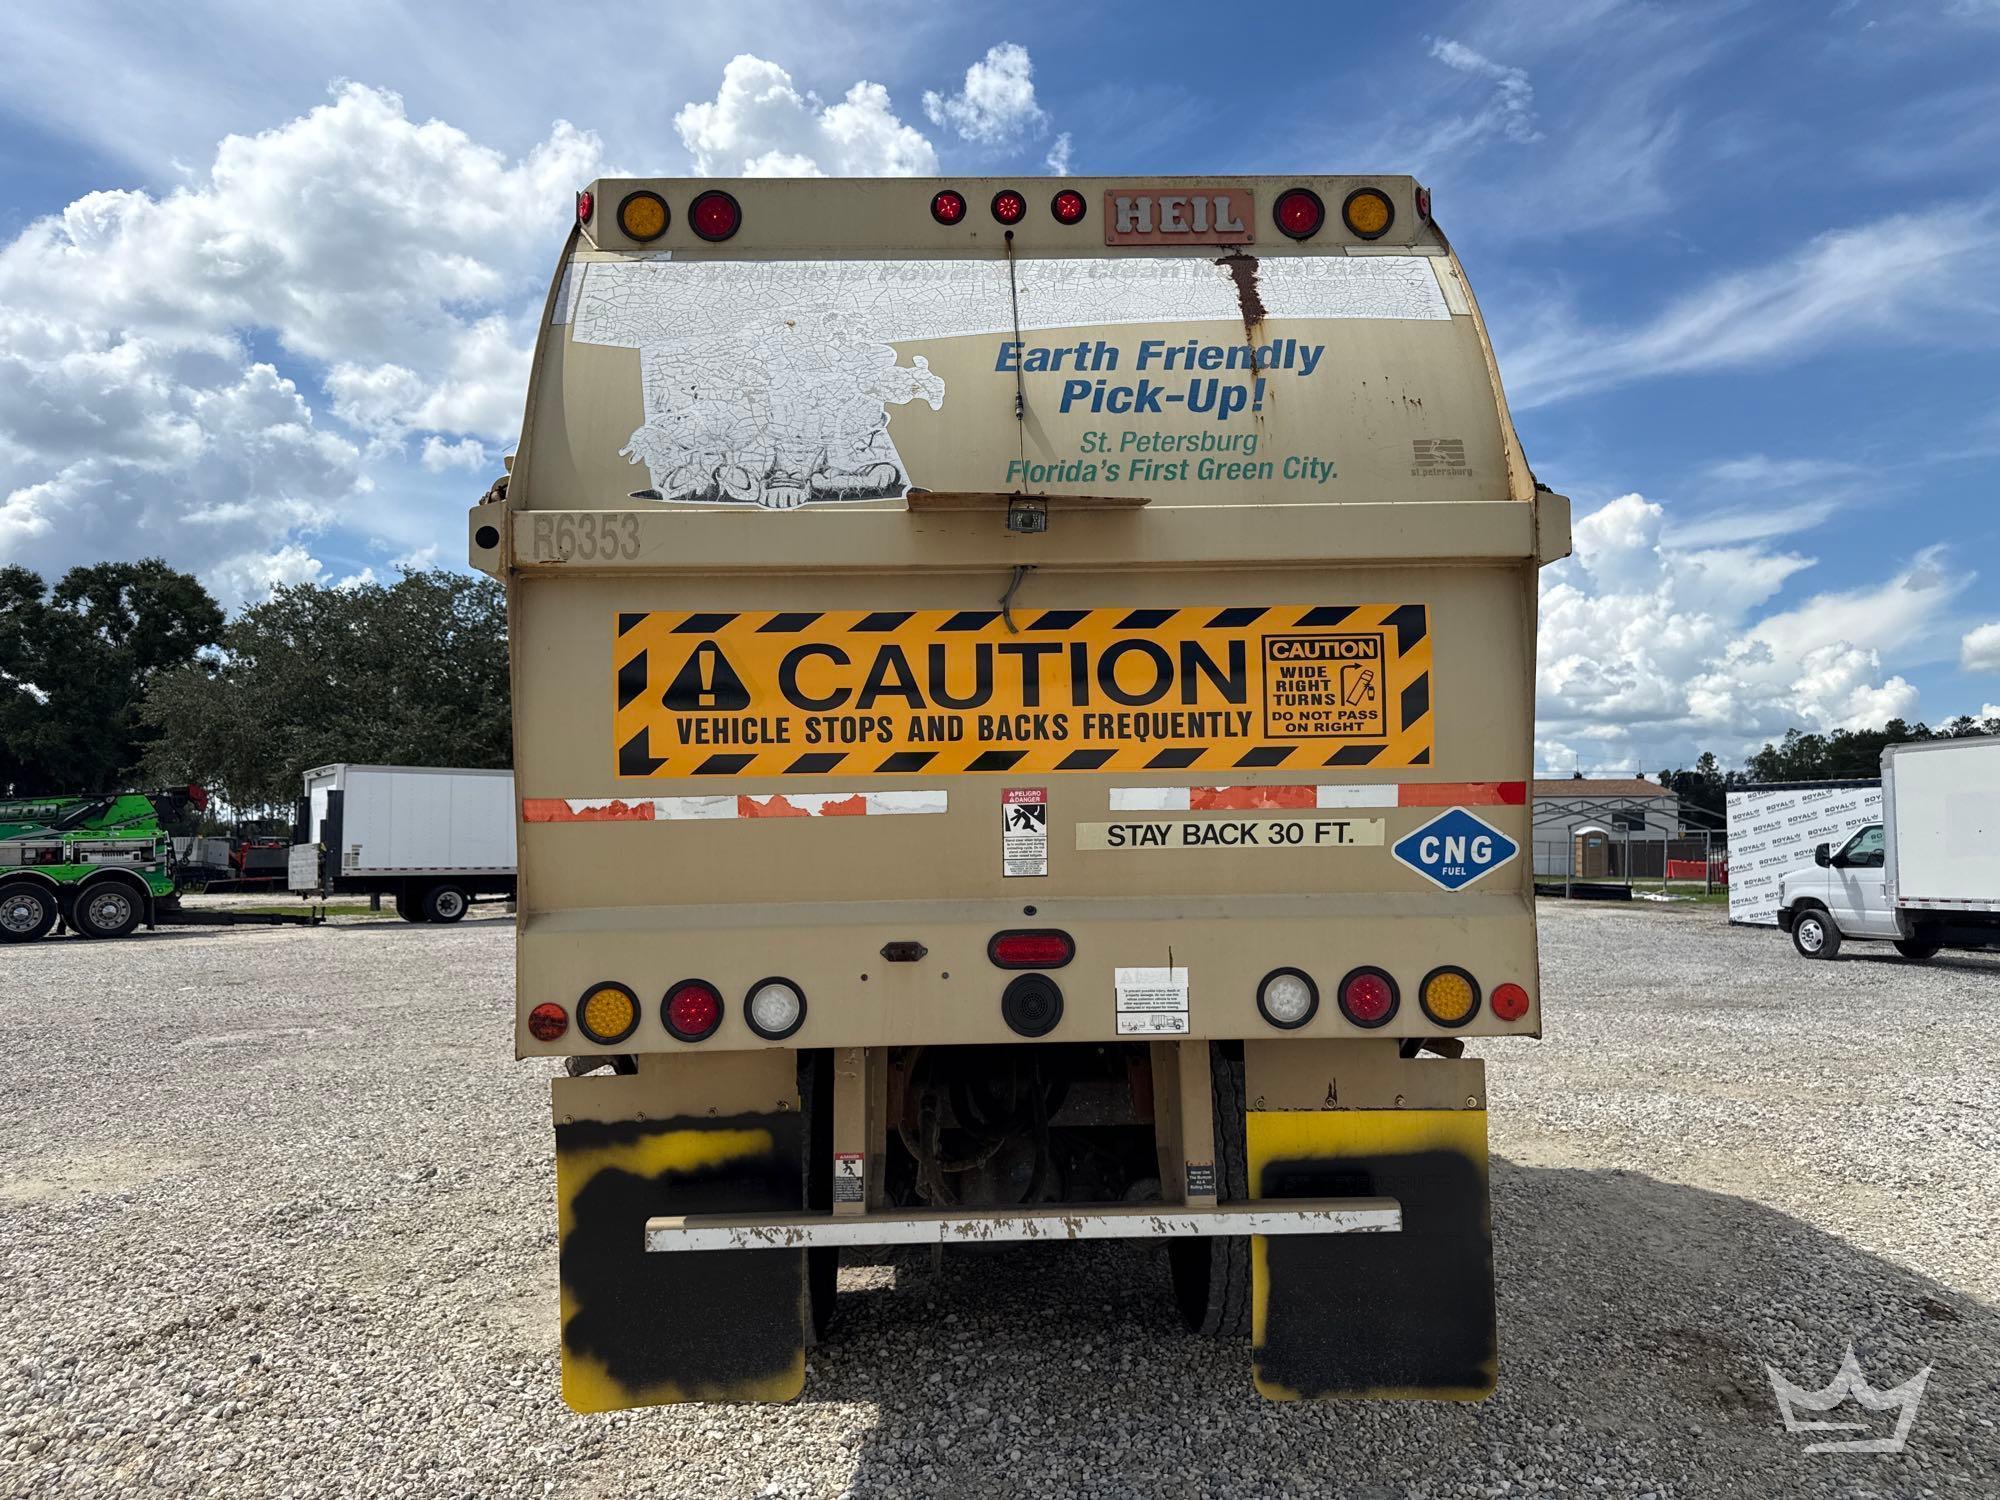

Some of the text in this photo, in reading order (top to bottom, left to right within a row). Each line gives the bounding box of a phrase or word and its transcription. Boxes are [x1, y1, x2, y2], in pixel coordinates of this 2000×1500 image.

[1115, 197, 1245, 233] HEIL
[995, 338, 1325, 377] Earth Friendly
[1059, 377, 1267, 421] Pick-Up!
[1080, 430, 1259, 456] St. Petersburg
[1005, 456, 1339, 484] Florida's First Green City.
[533, 513, 641, 561] R6353
[1272, 640, 1375, 659] CAUTION
[778, 639, 1247, 712] CAUTION
[1280, 666, 1327, 678] WIDE
[1275, 679, 1332, 692] RIGHT
[1273, 693, 1336, 706] TURNS
[1272, 710, 1378, 721] DO NOT PASS
[676, 710, 1252, 745] VEHICLE STOPS AND BACKS FREQUENTLY
[1285, 722, 1364, 732] ON RIGHT
[1802, 791, 1826, 801] ROYAL
[1864, 794, 1883, 803] ROY
[1766, 801, 1789, 811] ROYAL
[1824, 803, 1850, 813] ROYAL
[1732, 810, 1754, 820] ROYAL
[1787, 813, 1811, 824] ROYAL
[1846, 816, 1872, 826] ROYAL
[1753, 822, 1775, 832] ROYAL
[1808, 826, 1832, 836] ROYAL
[1107, 822, 1354, 847] STAY BACK 30 FT.
[1772, 835, 1795, 845] ROYAL
[1419, 835, 1492, 865] CNG
[1738, 844, 1760, 852] ROYAL
[1759, 856, 1782, 865] ROYAL
[1442, 867, 1466, 876] FUEL
[1744, 877, 1765, 885] ROYAL
[1731, 897, 1753, 905] ROYAL
[1750, 911, 1771, 919] ROYAL
